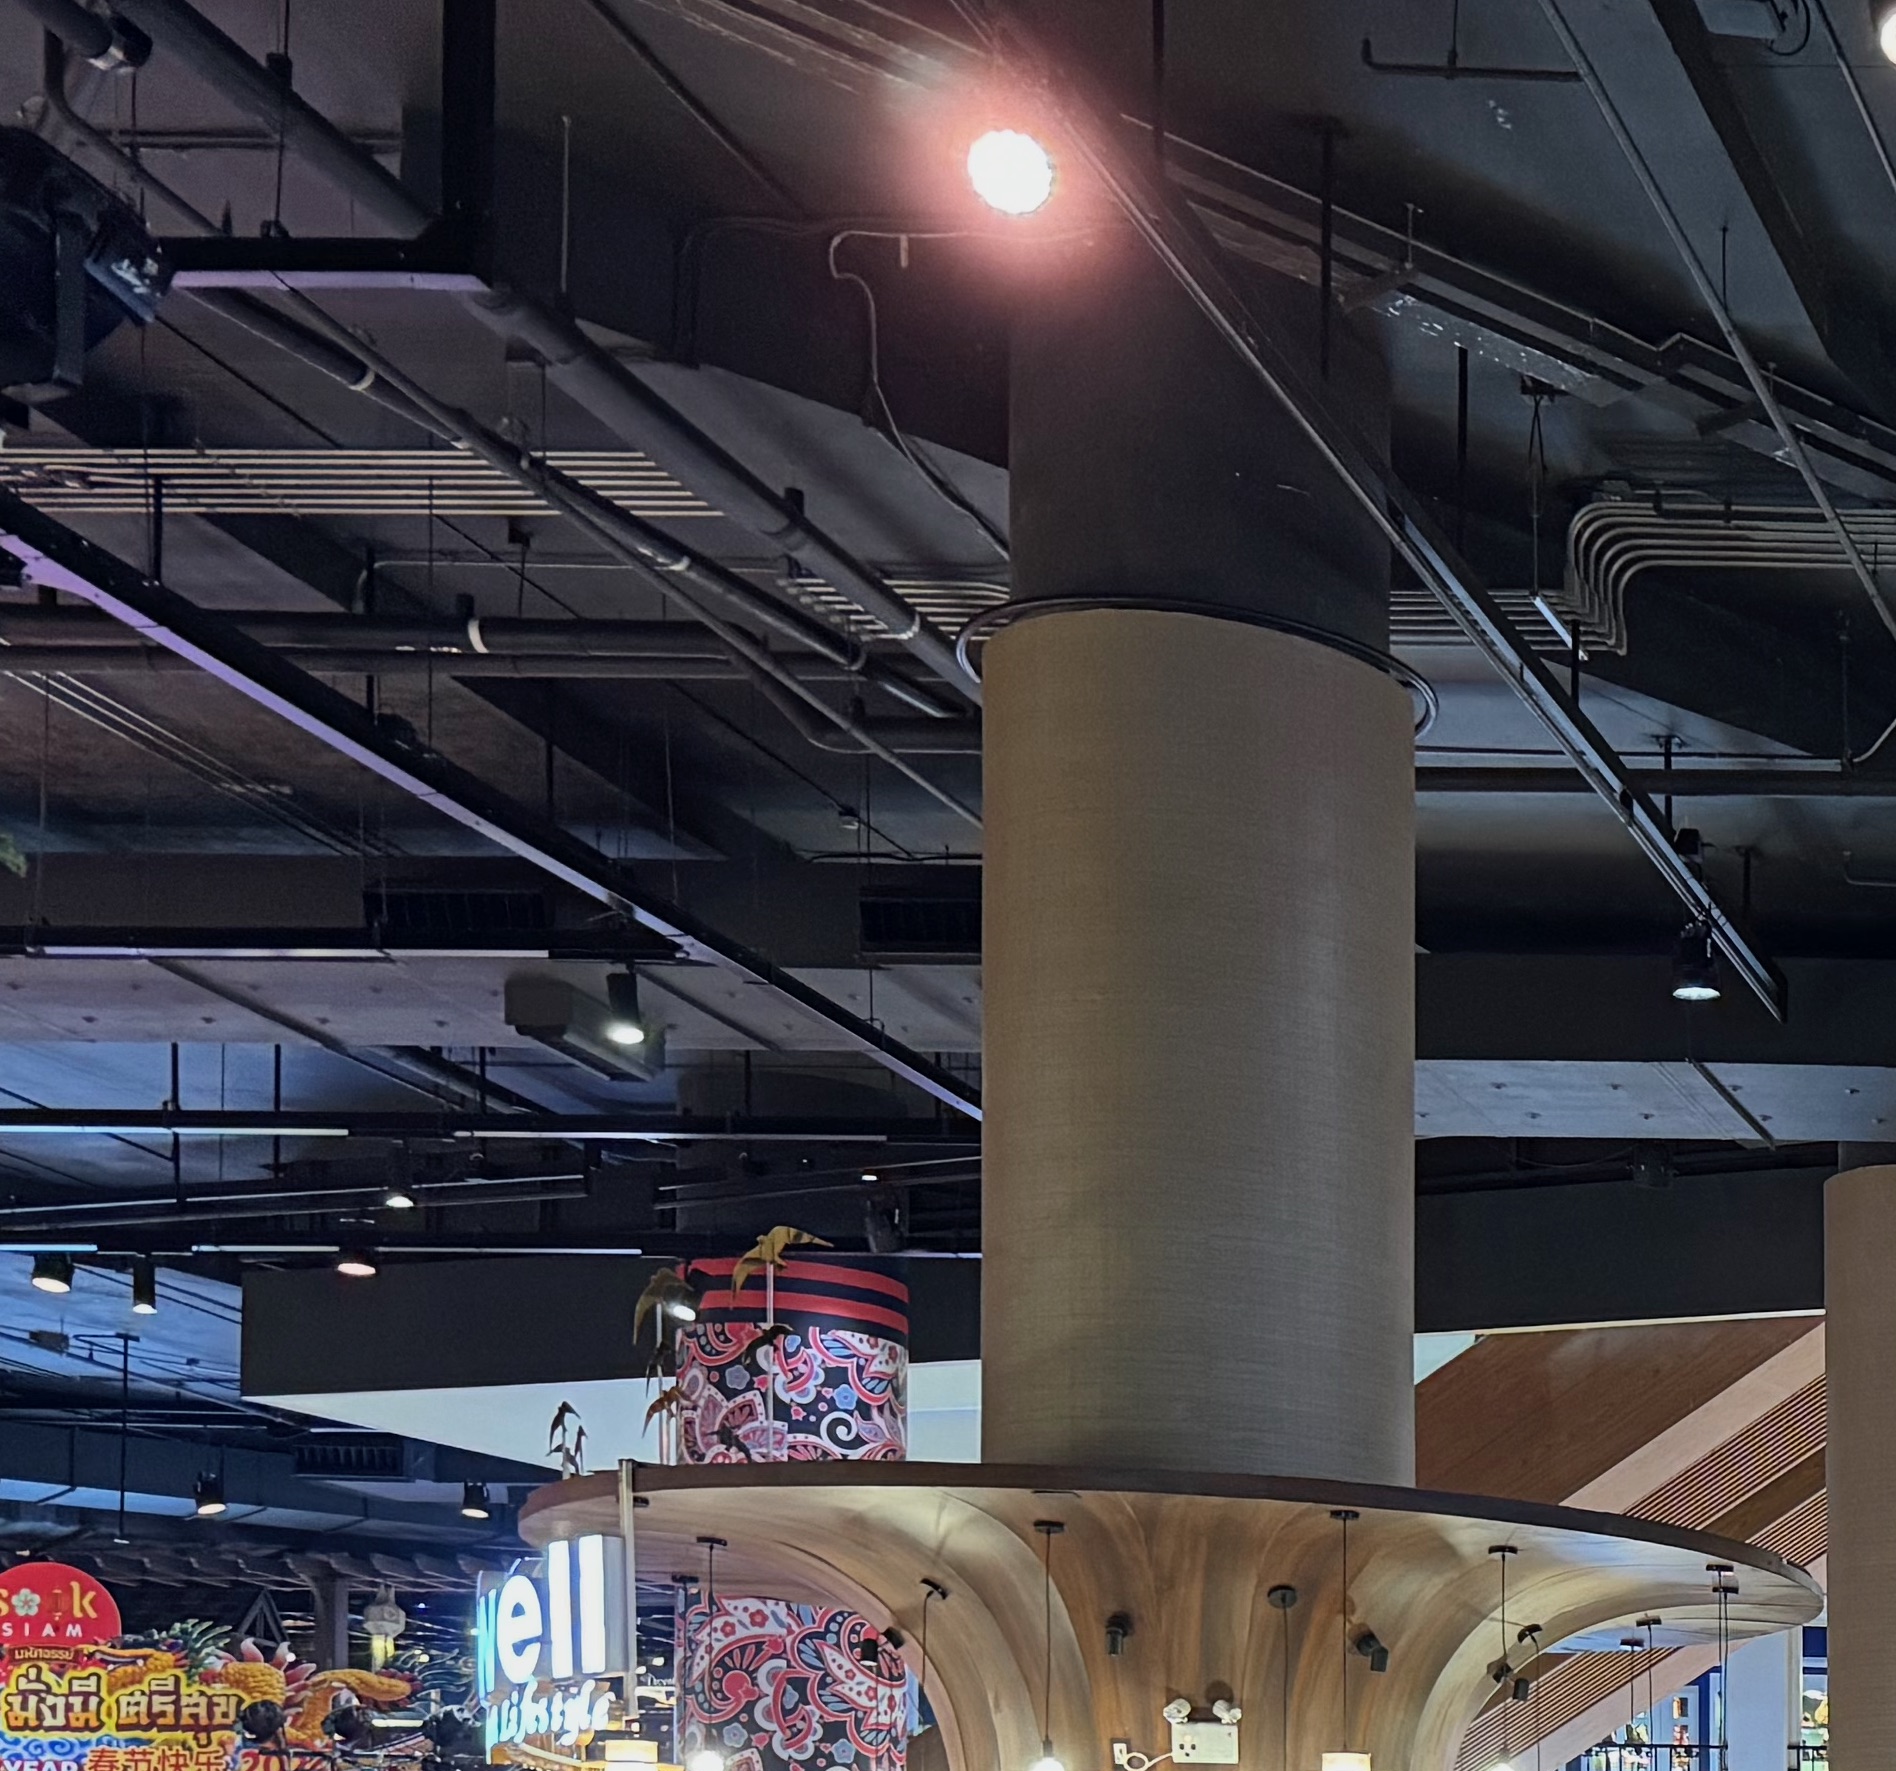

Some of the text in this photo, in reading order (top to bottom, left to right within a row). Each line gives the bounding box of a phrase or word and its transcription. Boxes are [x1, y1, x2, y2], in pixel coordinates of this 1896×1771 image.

[2, 1622, 82, 1637] SIAM
[6, 1666, 102, 1727] มั่งมี
